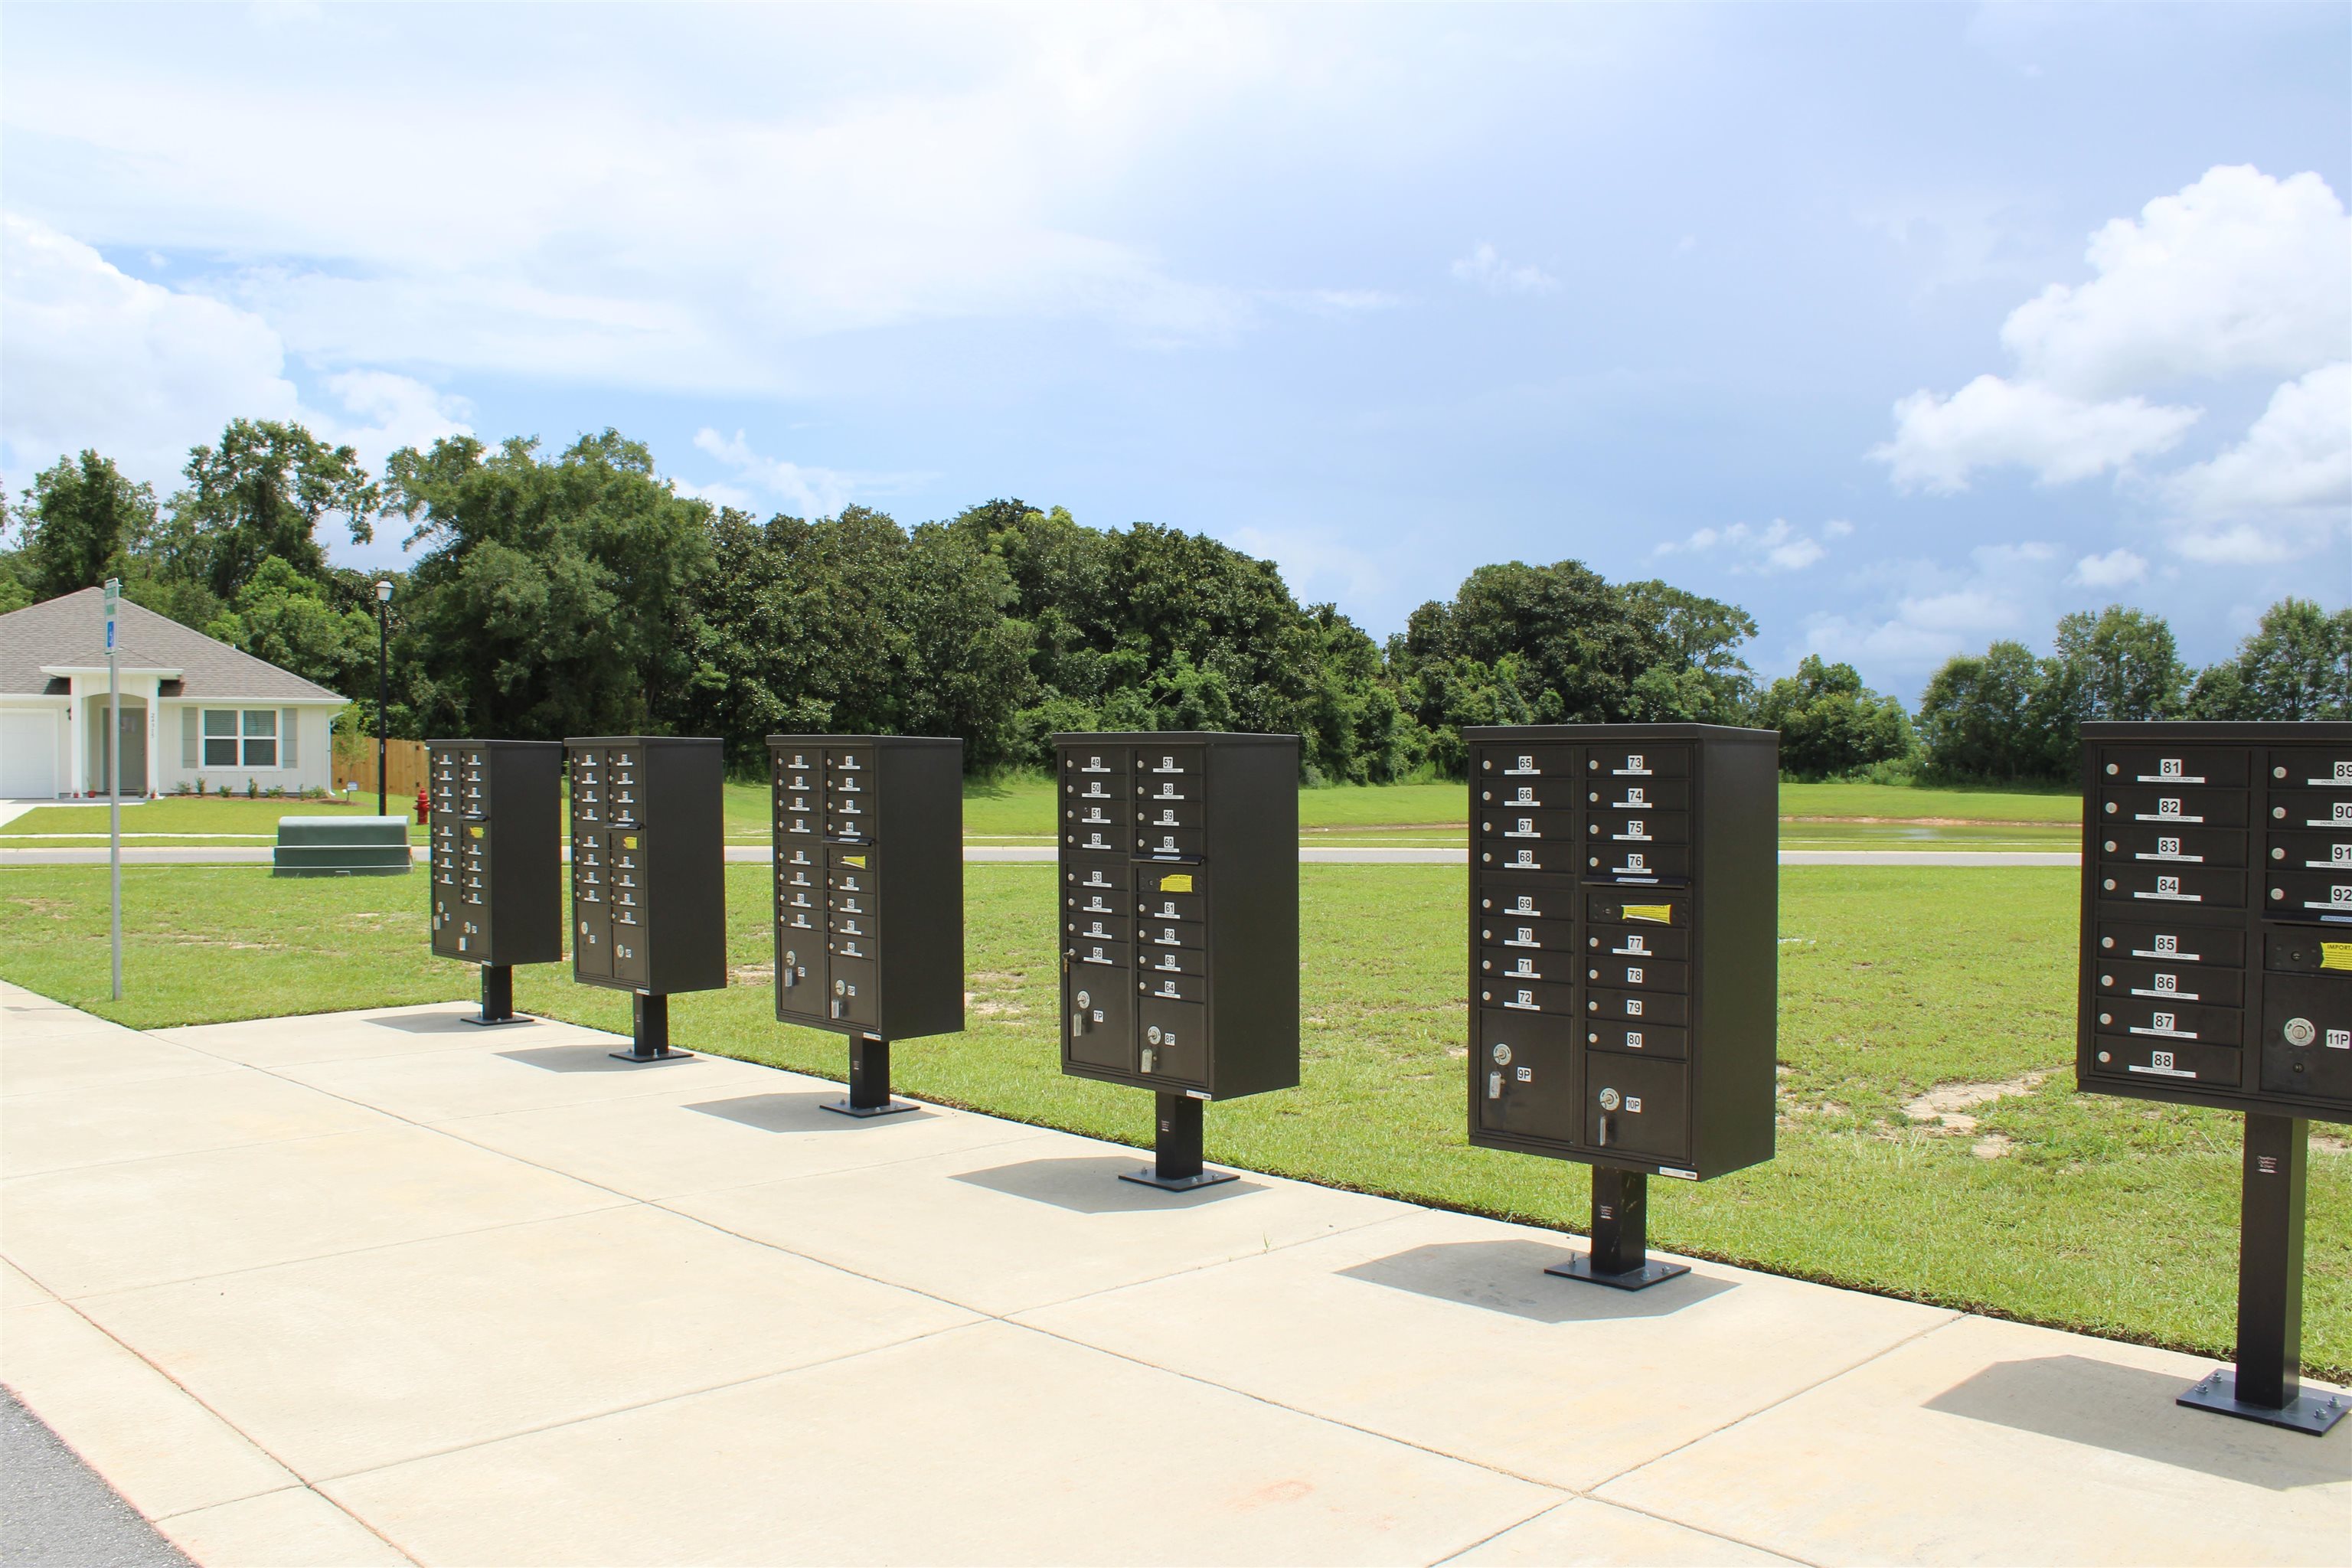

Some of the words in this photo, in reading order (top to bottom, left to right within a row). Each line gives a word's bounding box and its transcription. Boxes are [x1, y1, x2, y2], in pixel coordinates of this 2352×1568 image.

[1091, 758, 1100, 767] 49
[1164, 758, 1172, 767] 57
[1520, 758, 1531, 768] 65
[1629, 757, 1642, 768] 73
[2164, 762, 2179, 773] 81
[2337, 765, 2352, 777] 89
[1092, 784, 1100, 792] 50
[1164, 785, 1173, 794] 58
[1520, 789, 1531, 799] 66
[1629, 790, 1642, 800] 74
[2162, 801, 2178, 812] 82
[1093, 809, 1100, 817] 51
[1164, 811, 1173, 820] 59
[2335, 806, 2352, 818] 90
[1520, 820, 1531, 830] 67
[1629, 823, 1642, 833] 75
[1093, 835, 1100, 843] 52
[1165, 838, 1173, 847] 60
[2161, 840, 2177, 852] 83
[1520, 852, 1531, 862] 68
[2335, 847, 2351, 859] 91
[1629, 856, 1642, 866] 76
[1093, 873, 1101, 881] 53
[2160, 879, 2176, 891] 84
[2333, 889, 2352, 901] 92
[1093, 898, 1102, 907] 54
[1519, 898, 1531, 909] 69
[1166, 904, 1173, 912] 61
[1093, 924, 1101, 932] 55
[1165, 930, 1174, 939] 62
[1519, 930, 1530, 940] 70
[1629, 938, 1641, 948] 77
[2158, 938, 2174, 950] 85
[1094, 949, 1102, 957] 56
[1166, 956, 1175, 965] 63
[1519, 961, 1530, 971] 71
[1629, 970, 1641, 981] 78
[1166, 983, 1174, 991] 64
[2157, 977, 2174, 988] 86
[1519, 992, 1531, 1003] 72
[1628, 1002, 1641, 1013] 79
[1094, 1012, 1103, 1021] 7P
[2156, 1016, 2172, 1027] 87
[1165, 1035, 1175, 1044] 8P
[1628, 1034, 1641, 1045] 80
[2328, 1033, 2348, 1045] 11P
[2155, 1054, 2171, 1067] 88
[1518, 1069, 1530, 1079] 9P
[1627, 1099, 1640, 1110] 10P
